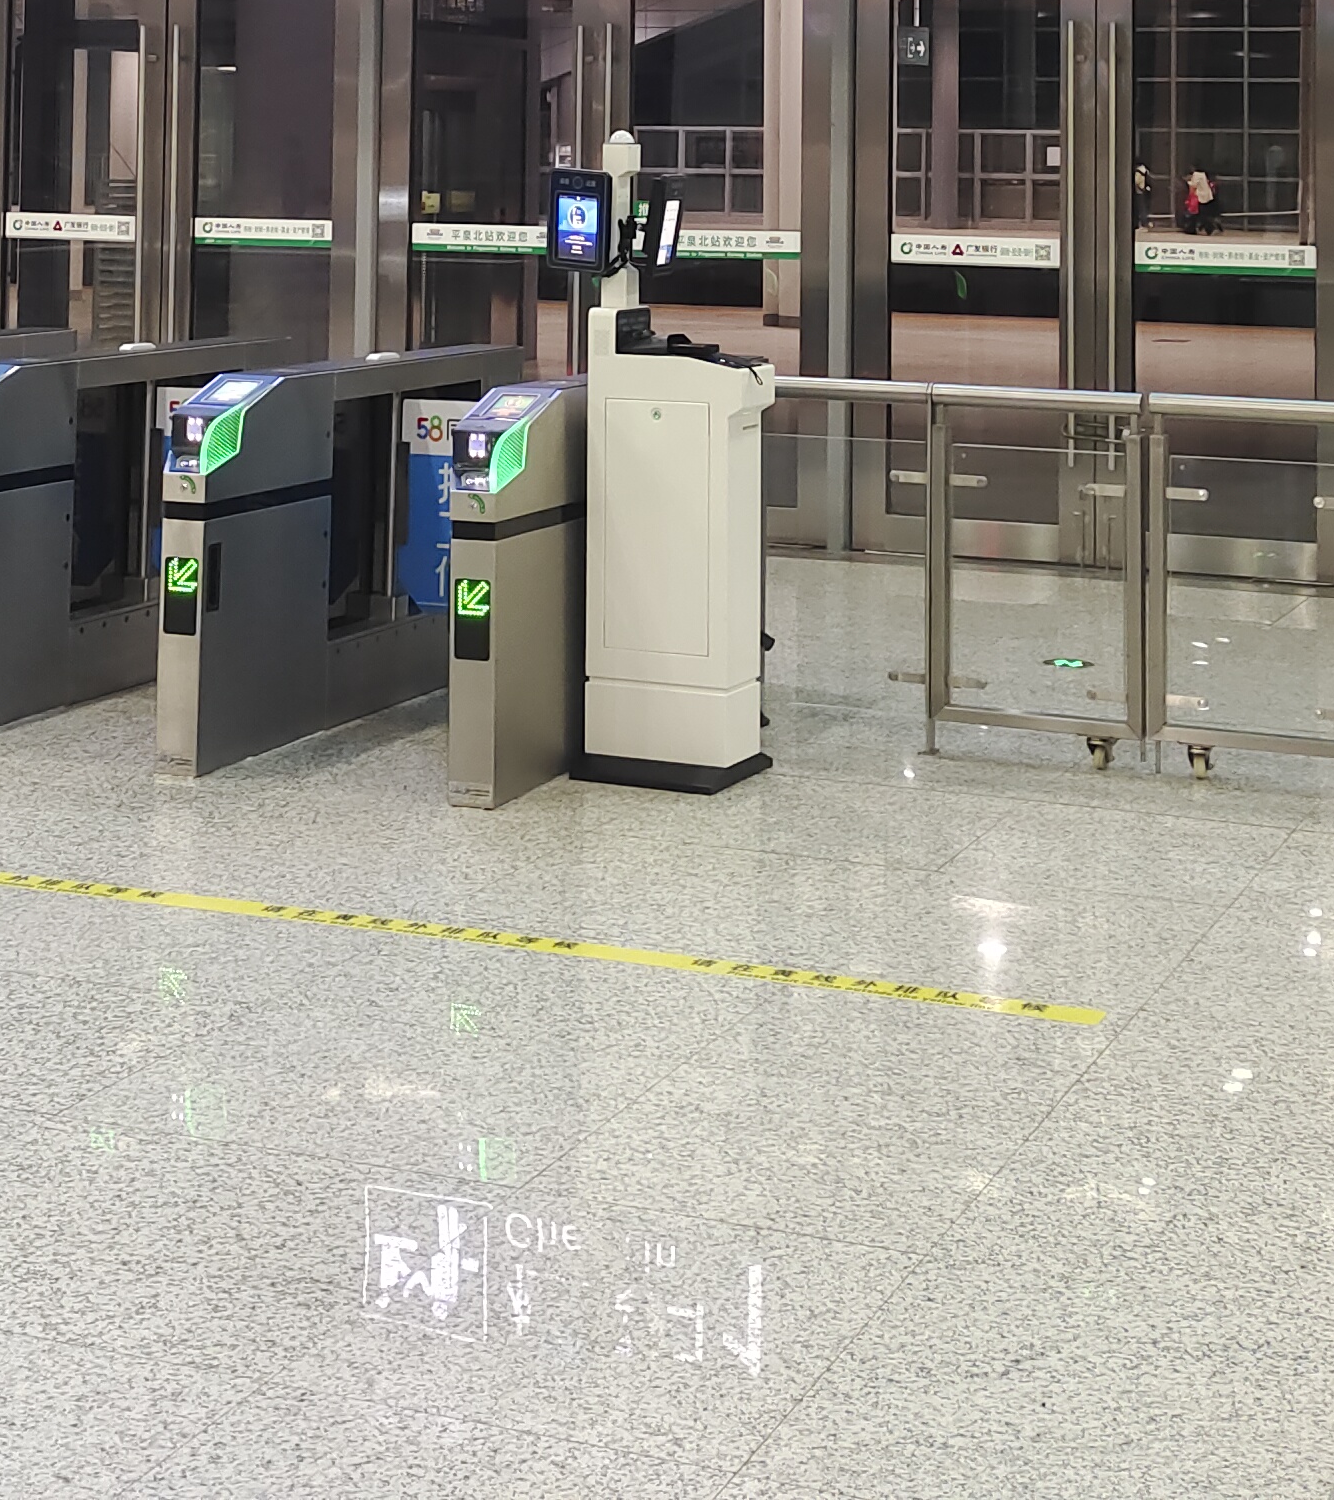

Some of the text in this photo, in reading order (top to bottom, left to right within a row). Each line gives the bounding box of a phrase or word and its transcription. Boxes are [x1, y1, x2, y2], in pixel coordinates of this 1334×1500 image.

[451, 229, 528, 242] 平泉北站欢迎您
